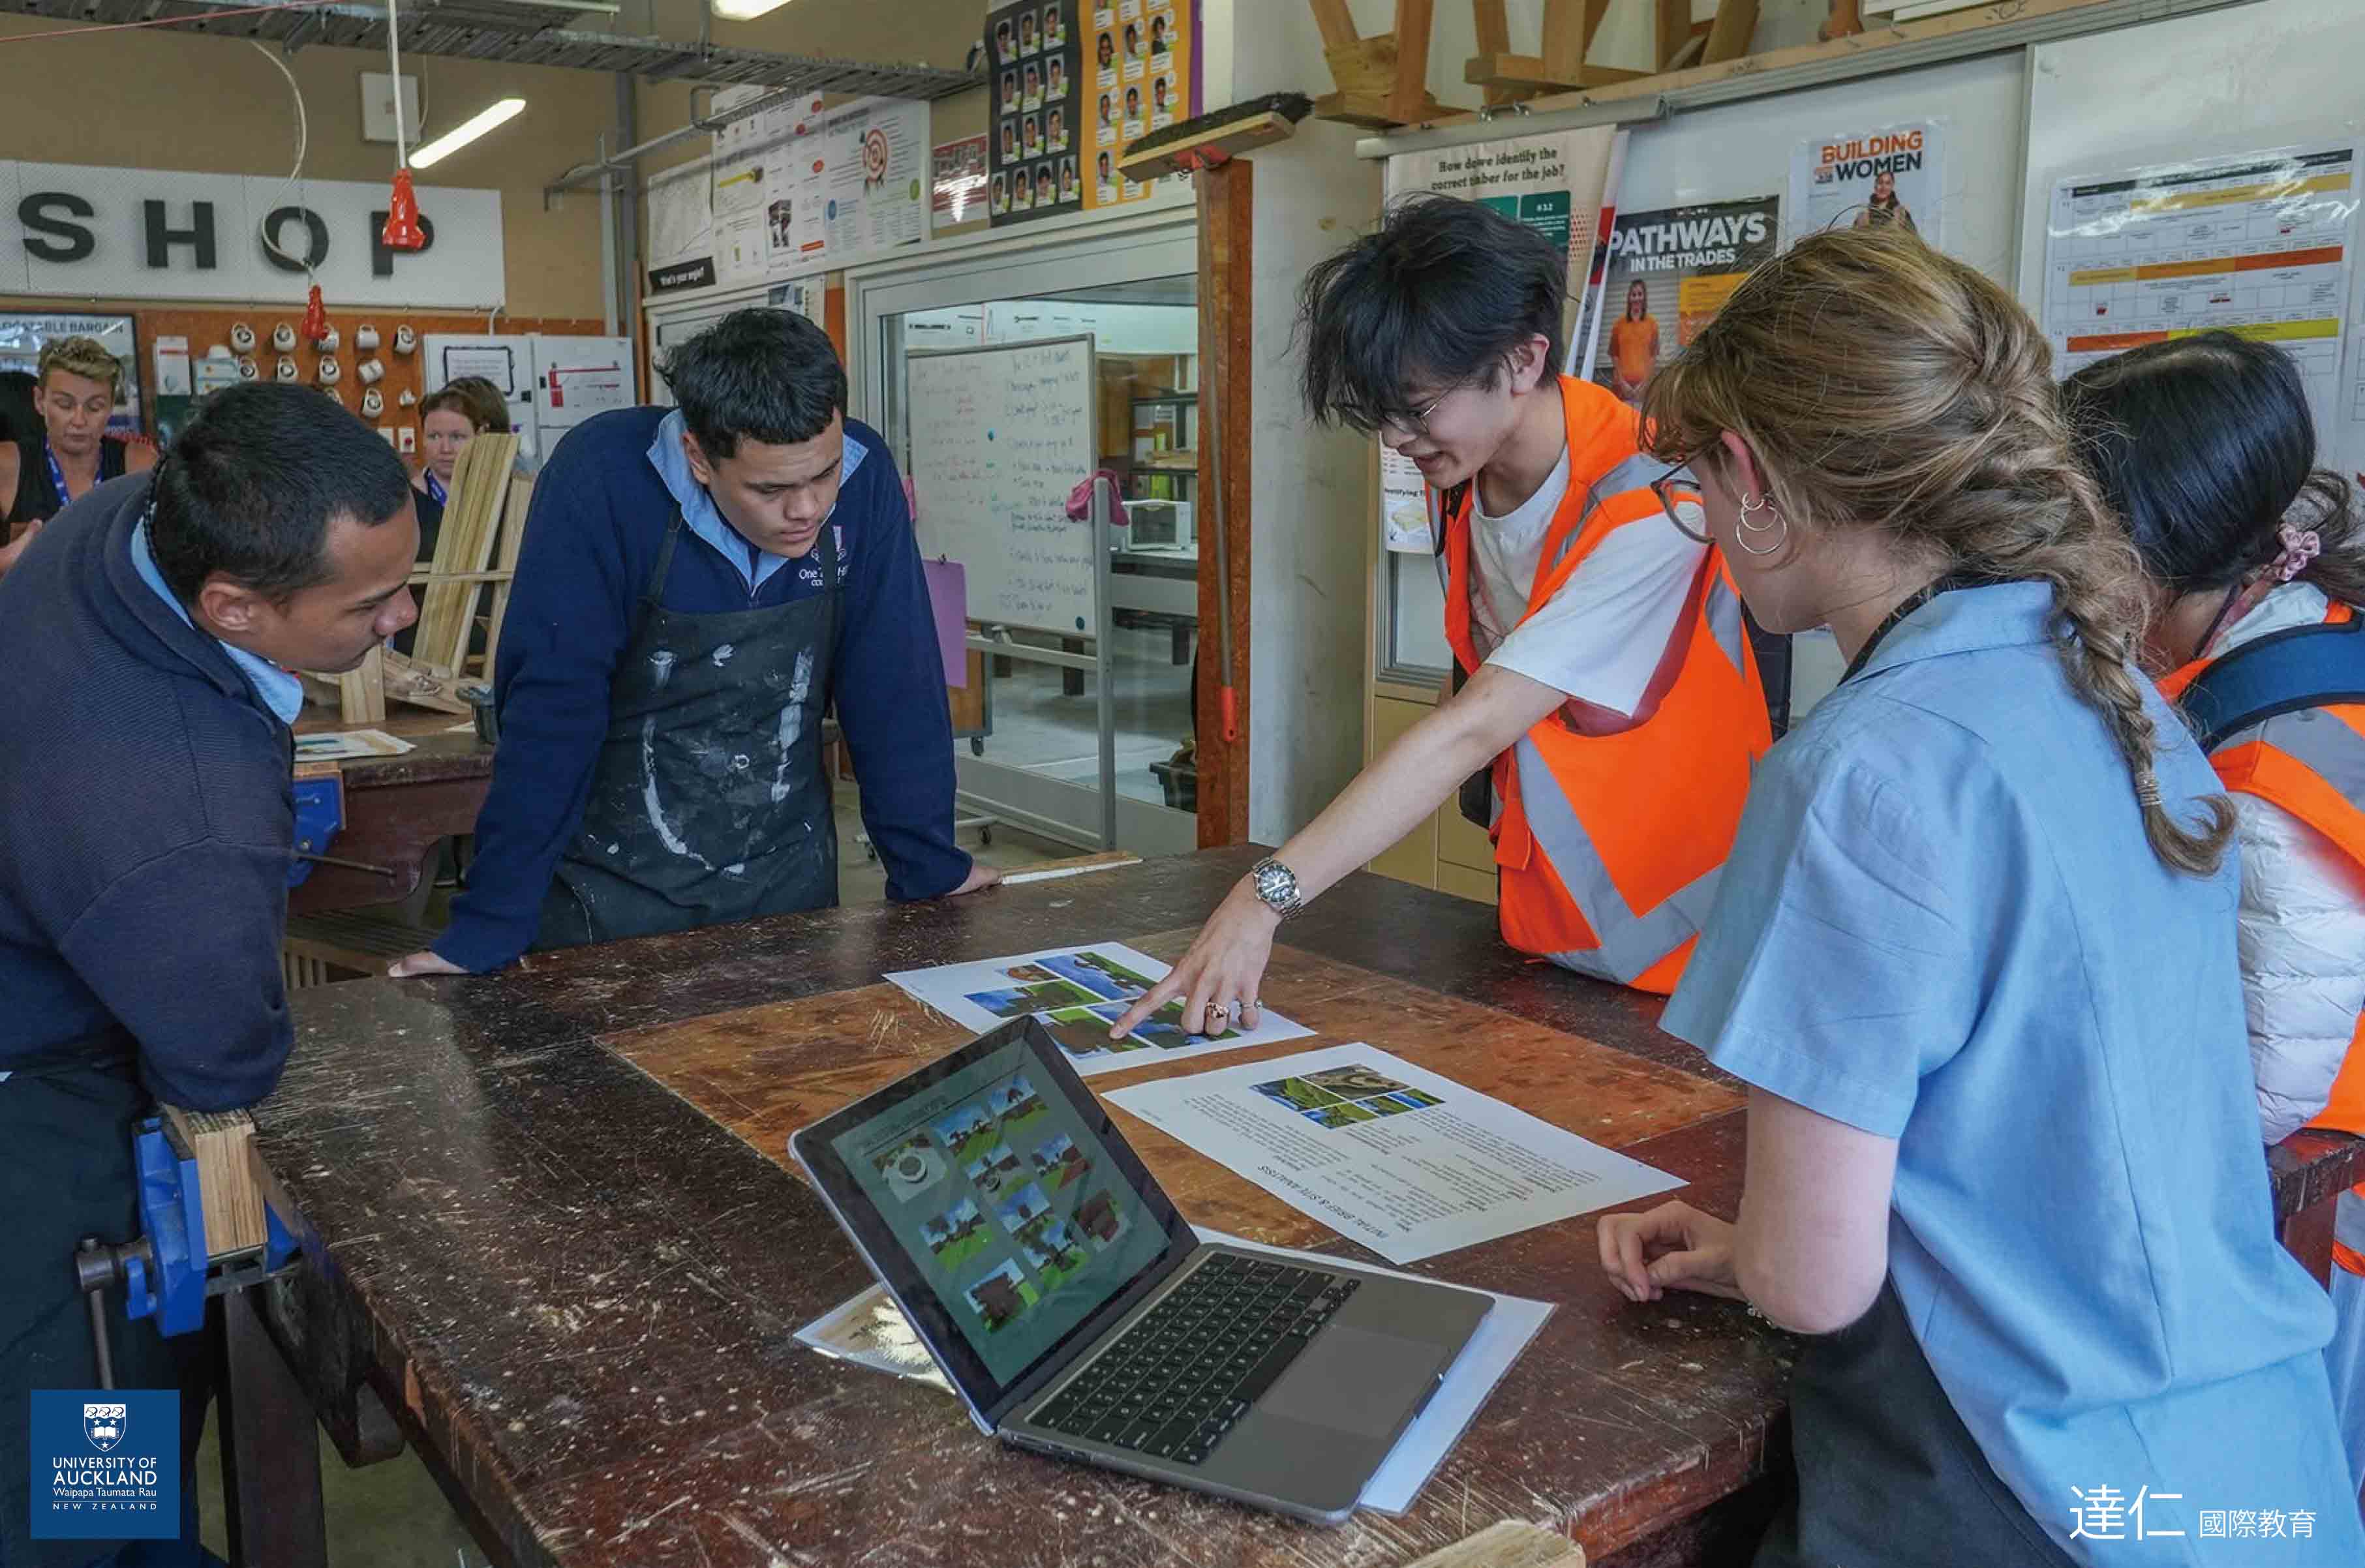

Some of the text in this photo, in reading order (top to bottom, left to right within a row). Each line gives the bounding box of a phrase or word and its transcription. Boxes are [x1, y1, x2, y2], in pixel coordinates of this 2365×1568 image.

[1496, 150, 1536, 164] identify
[1540, 148, 1557, 160] the
[1822, 130, 1923, 164] BUILDING
[1431, 178, 1467, 190] correct
[1503, 170, 1519, 182] for
[1522, 167, 1538, 180] the
[1542, 164, 1565, 181] job?
[1836, 151, 1922, 181] WOMEN
[17, 192, 435, 277] SHOP
[1610, 212, 1767, 256] PATHWAYS
[1632, 248, 1735, 272] IN THE TRADES
[799, 568, 817, 579] One
